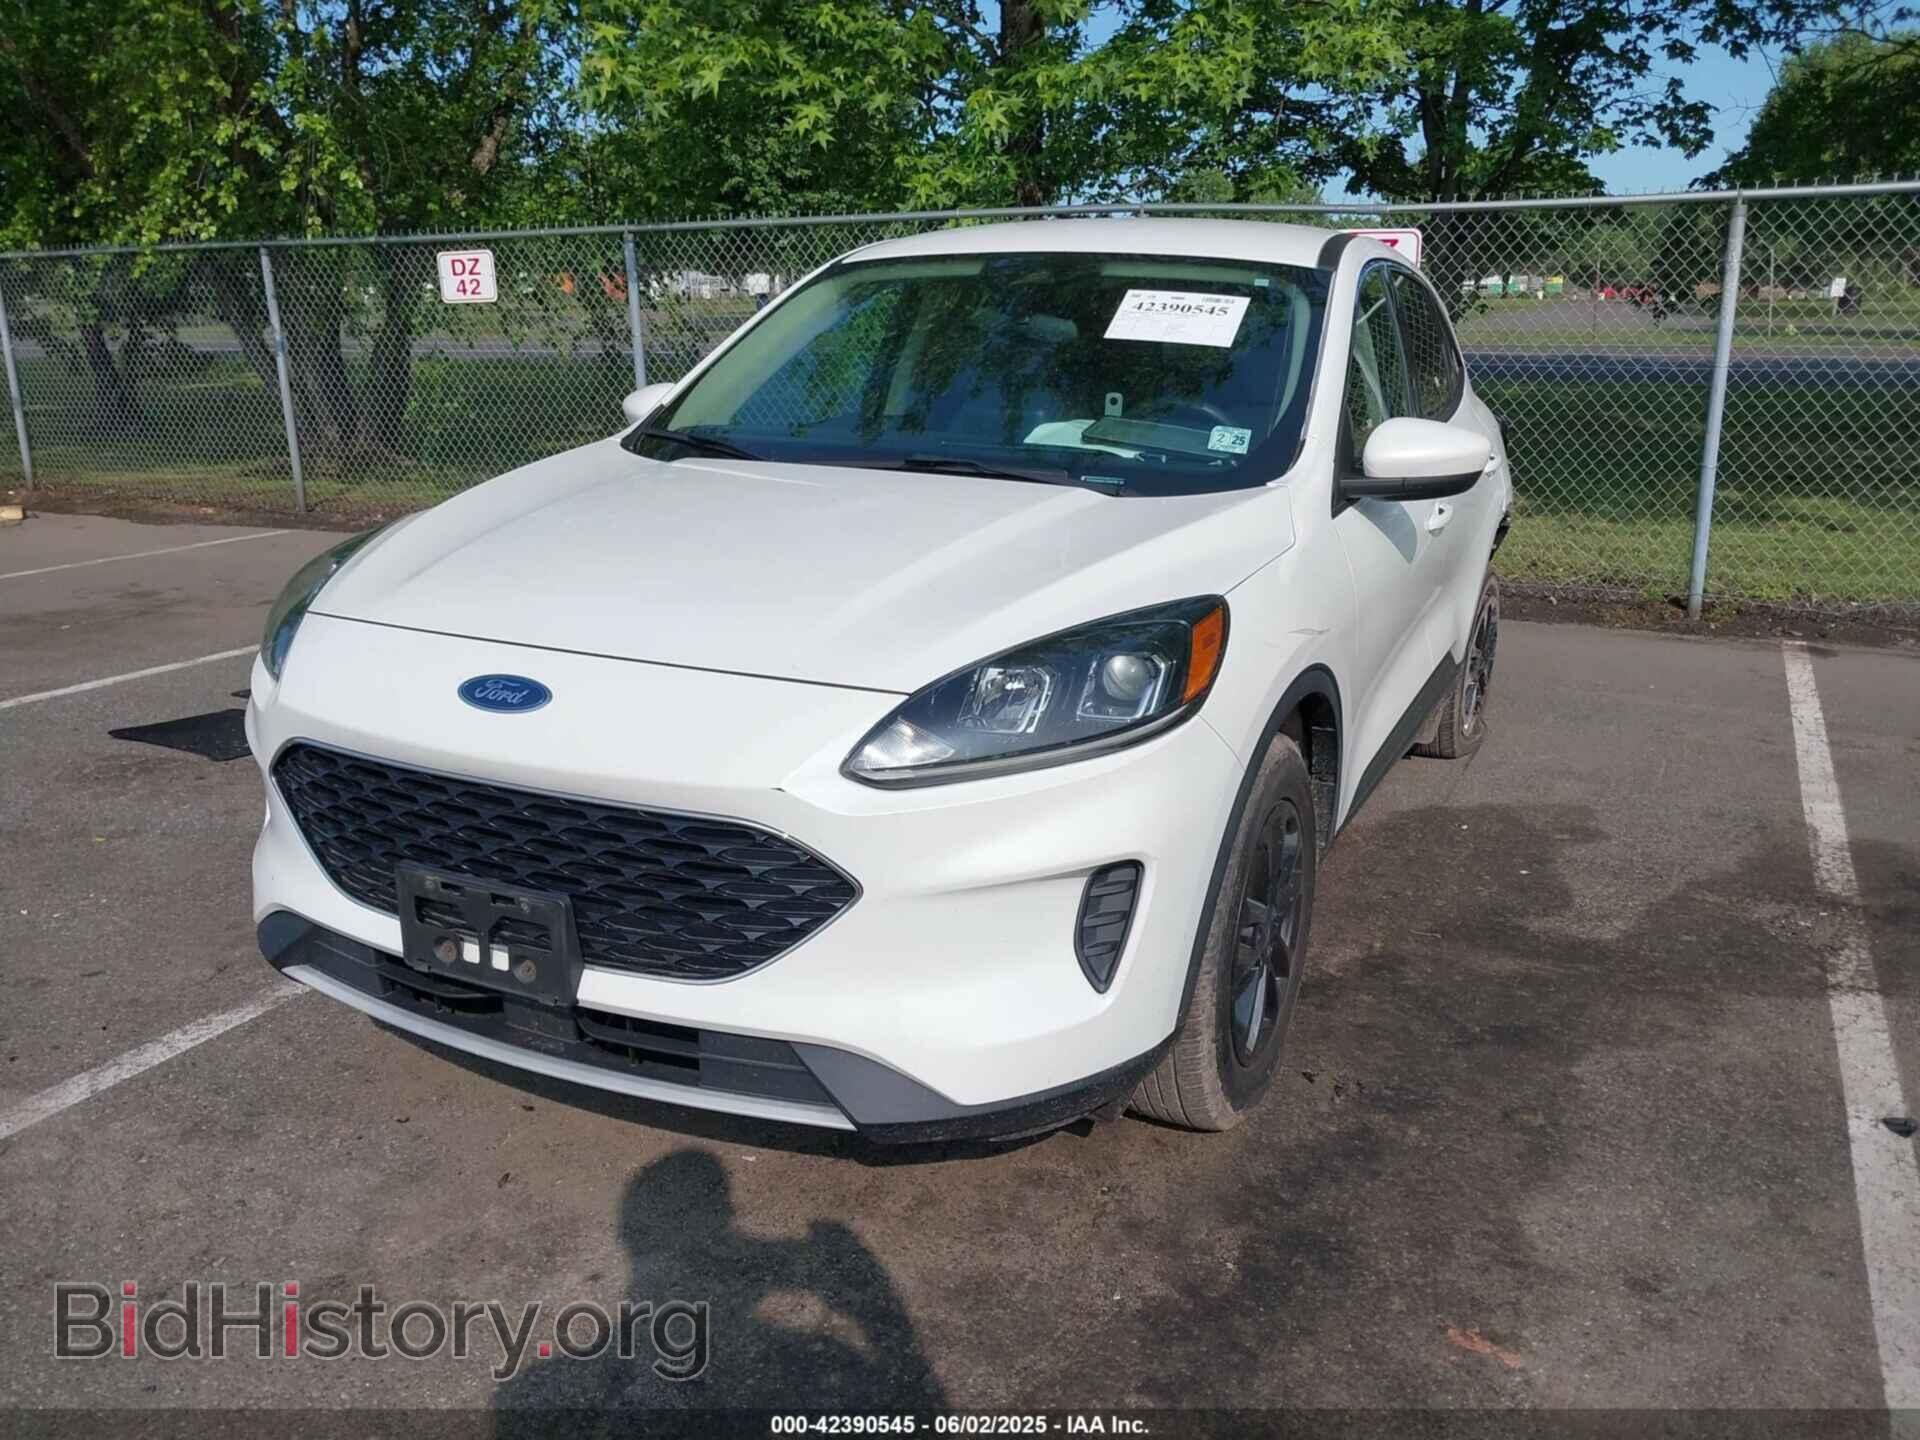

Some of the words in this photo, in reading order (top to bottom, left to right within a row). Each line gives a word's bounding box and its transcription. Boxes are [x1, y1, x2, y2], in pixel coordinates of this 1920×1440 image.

[451, 258, 481, 276] DZ
[456, 278, 481, 296] 42
[1132, 301, 1230, 317] 42390545
[1216, 433, 1225, 444] 2
[1231, 435, 1246, 446] 25
[474, 679, 529, 704] Ford
